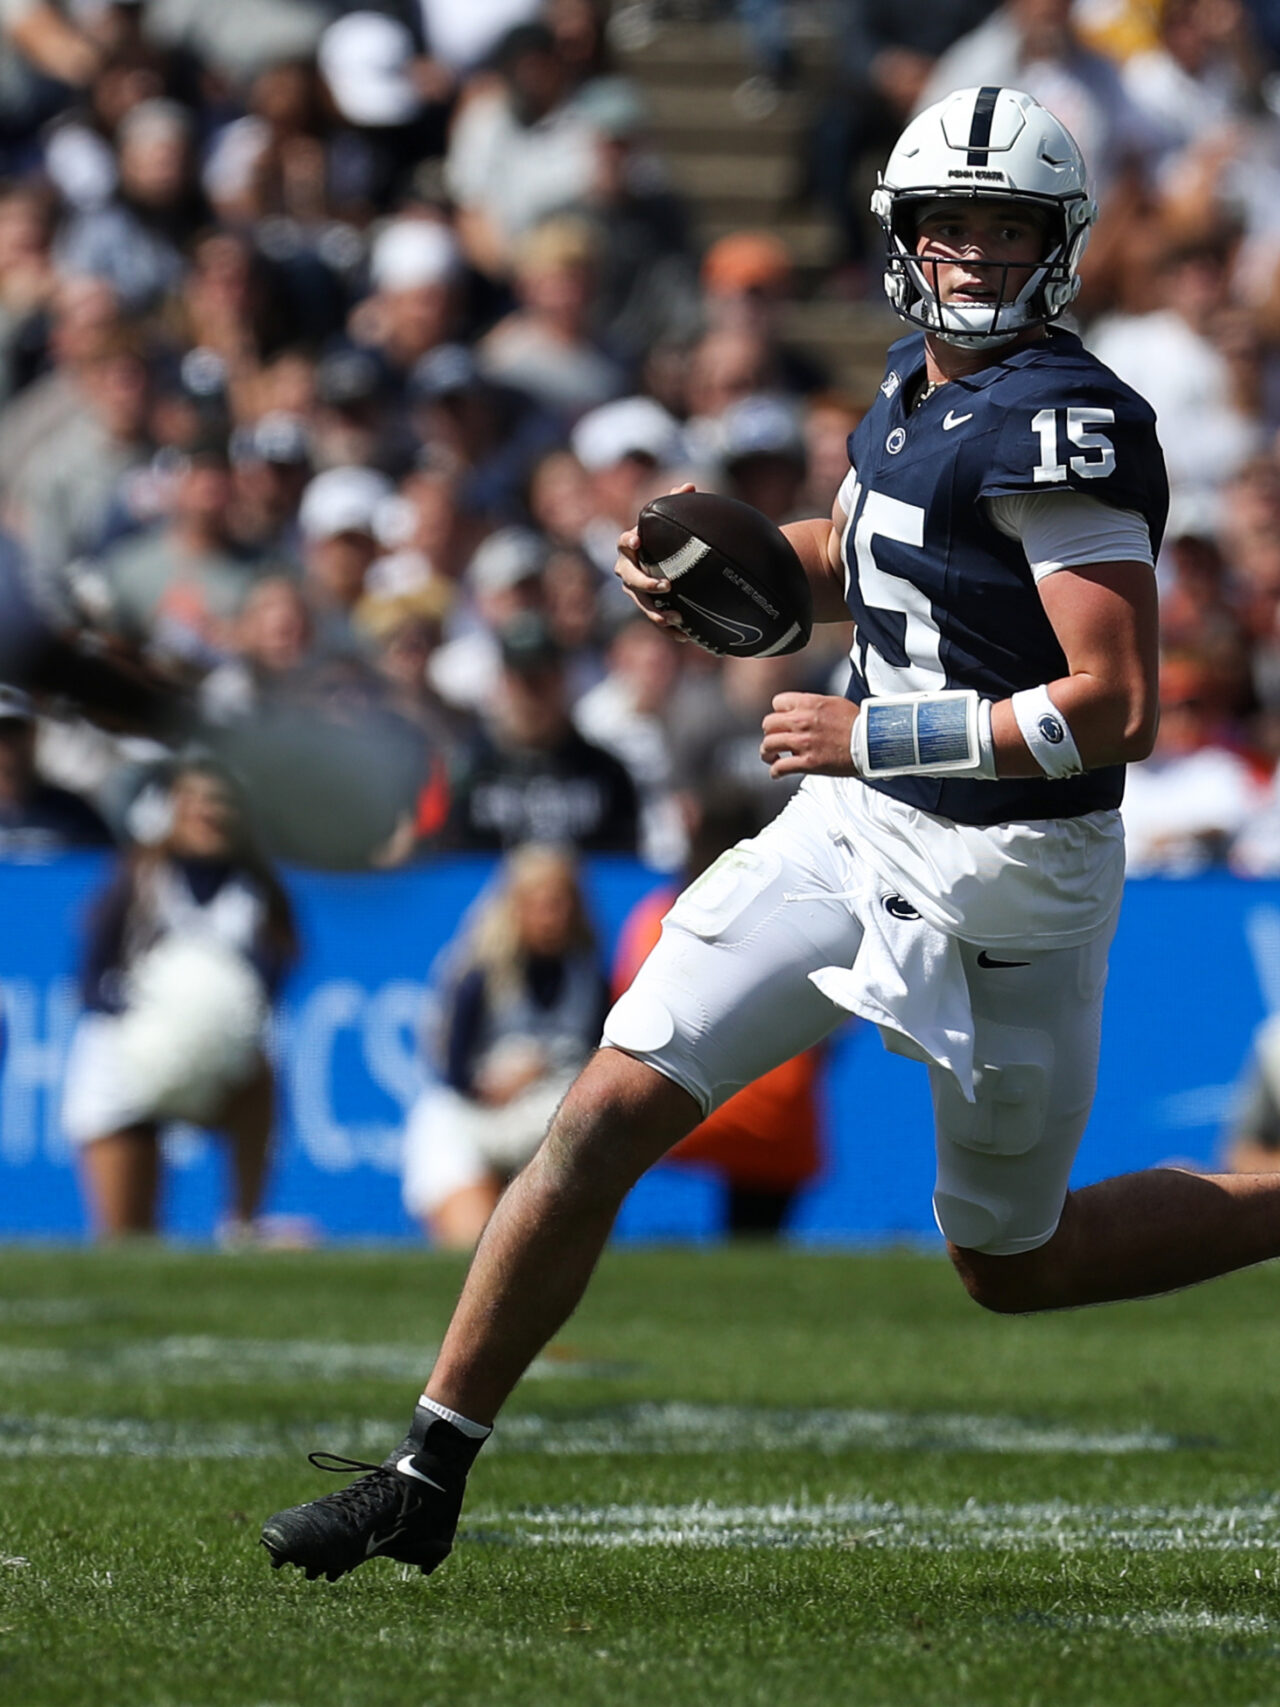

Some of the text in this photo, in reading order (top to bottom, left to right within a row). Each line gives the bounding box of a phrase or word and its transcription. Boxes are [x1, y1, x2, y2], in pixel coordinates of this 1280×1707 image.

[948, 169, 1005, 182] PENN STATE
[1031, 407, 1116, 483] 15
